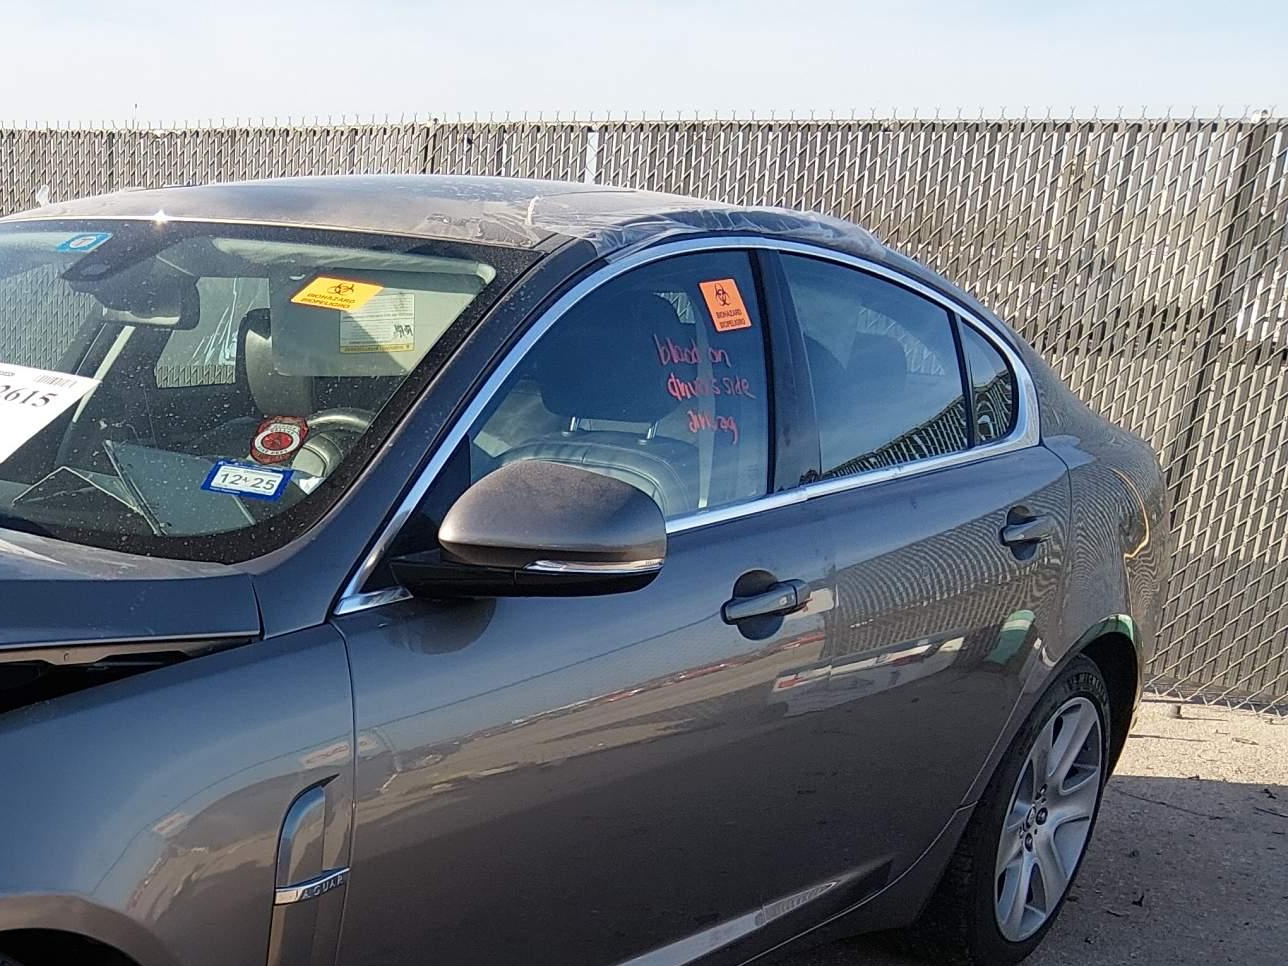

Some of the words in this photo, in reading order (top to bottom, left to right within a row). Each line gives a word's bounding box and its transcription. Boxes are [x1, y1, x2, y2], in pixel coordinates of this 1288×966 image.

[307, 293, 356, 304] BIOHAZARD
[716, 309, 743, 319] BIOHAZARD
[654, 333, 701, 367] blood
[708, 347, 732, 369] on
[722, 374, 758, 400] side
[220, 473, 242, 486] 12
[250, 477, 277, 491] 25
